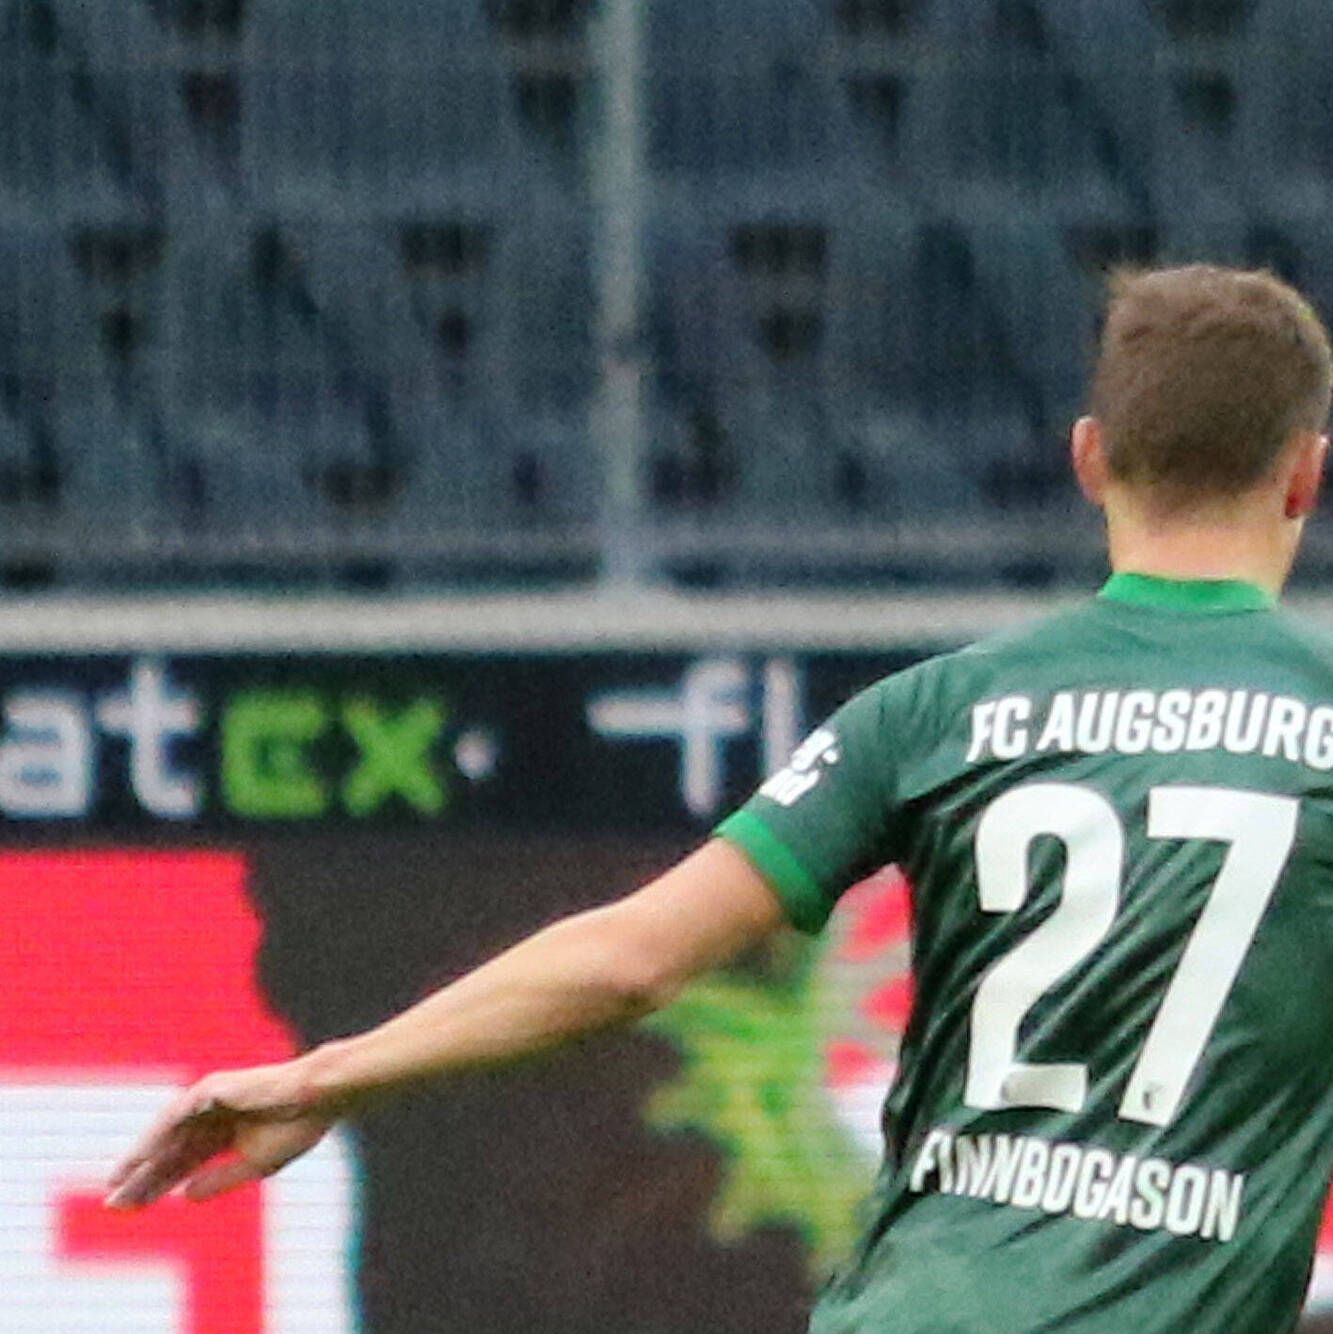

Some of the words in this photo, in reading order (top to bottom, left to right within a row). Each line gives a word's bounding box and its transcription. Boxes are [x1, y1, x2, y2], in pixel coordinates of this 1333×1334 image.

[966, 695, 1033, 764] FC
[964, 783, 1301, 1128] 27
[908, 1129, 1244, 1242] FINNBOGASON
